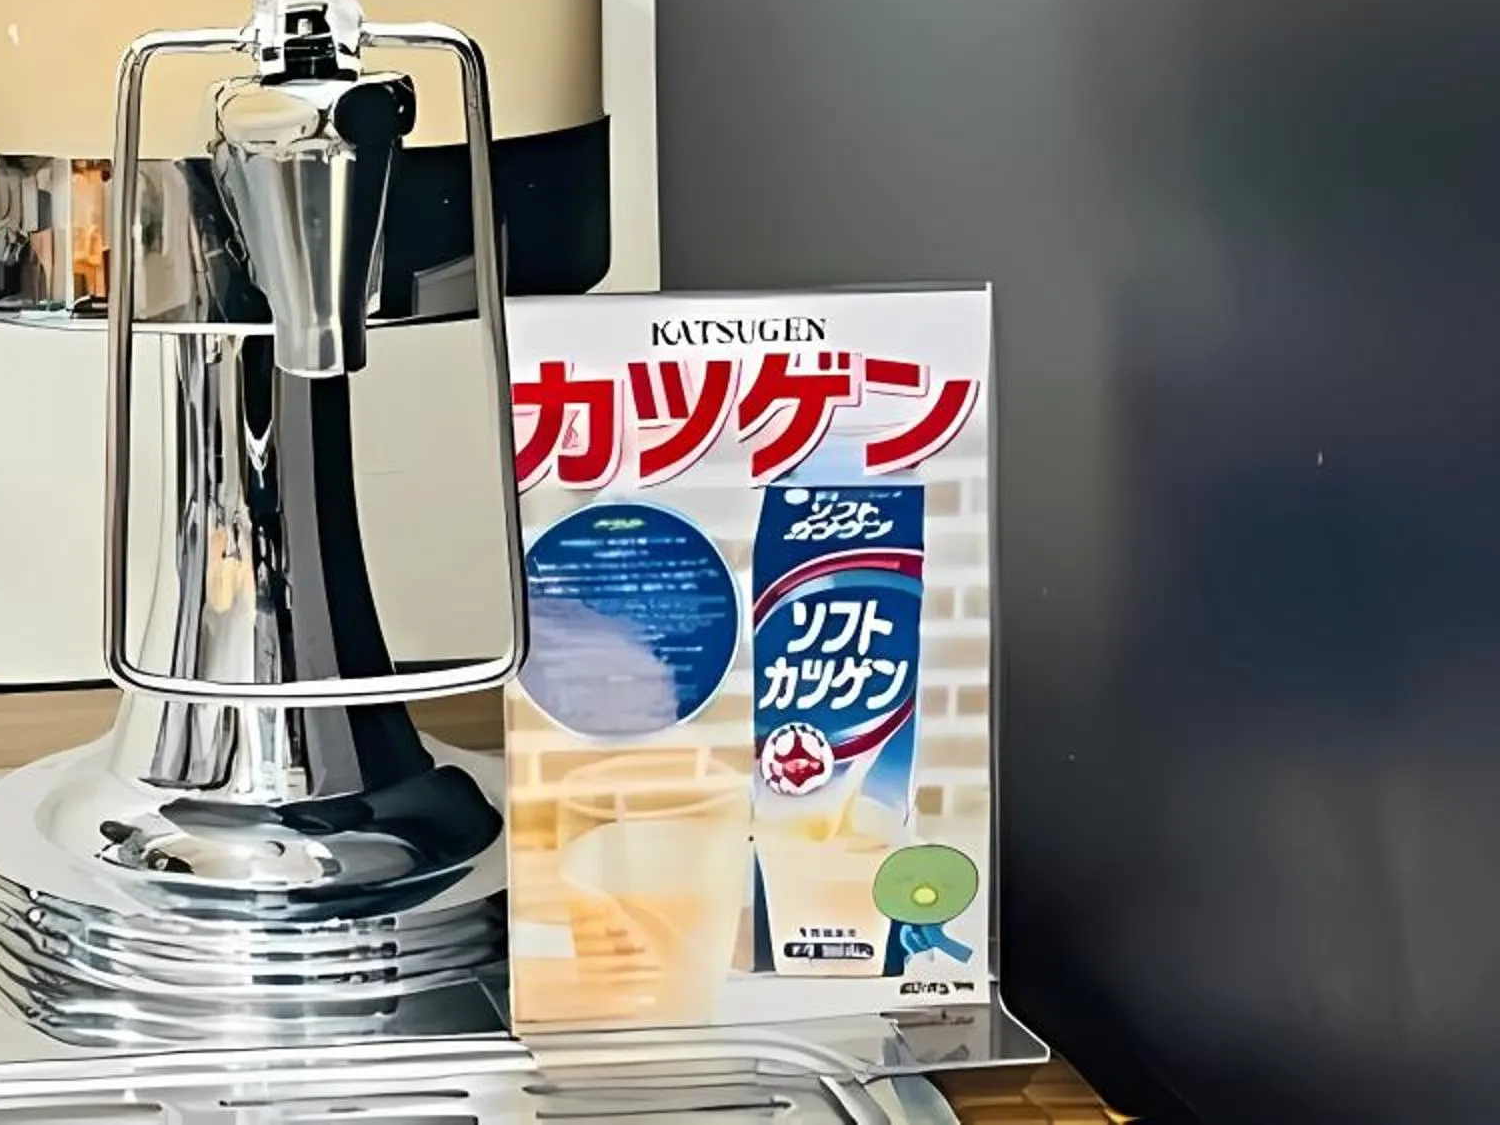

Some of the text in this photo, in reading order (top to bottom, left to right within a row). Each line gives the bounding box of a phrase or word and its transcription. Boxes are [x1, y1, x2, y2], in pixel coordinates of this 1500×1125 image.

[651, 316, 827, 346] KATSUGEN
[511, 351, 978, 493] カツゲン
[787, 599, 894, 656] ソフト
[758, 656, 909, 711] カツゲン
